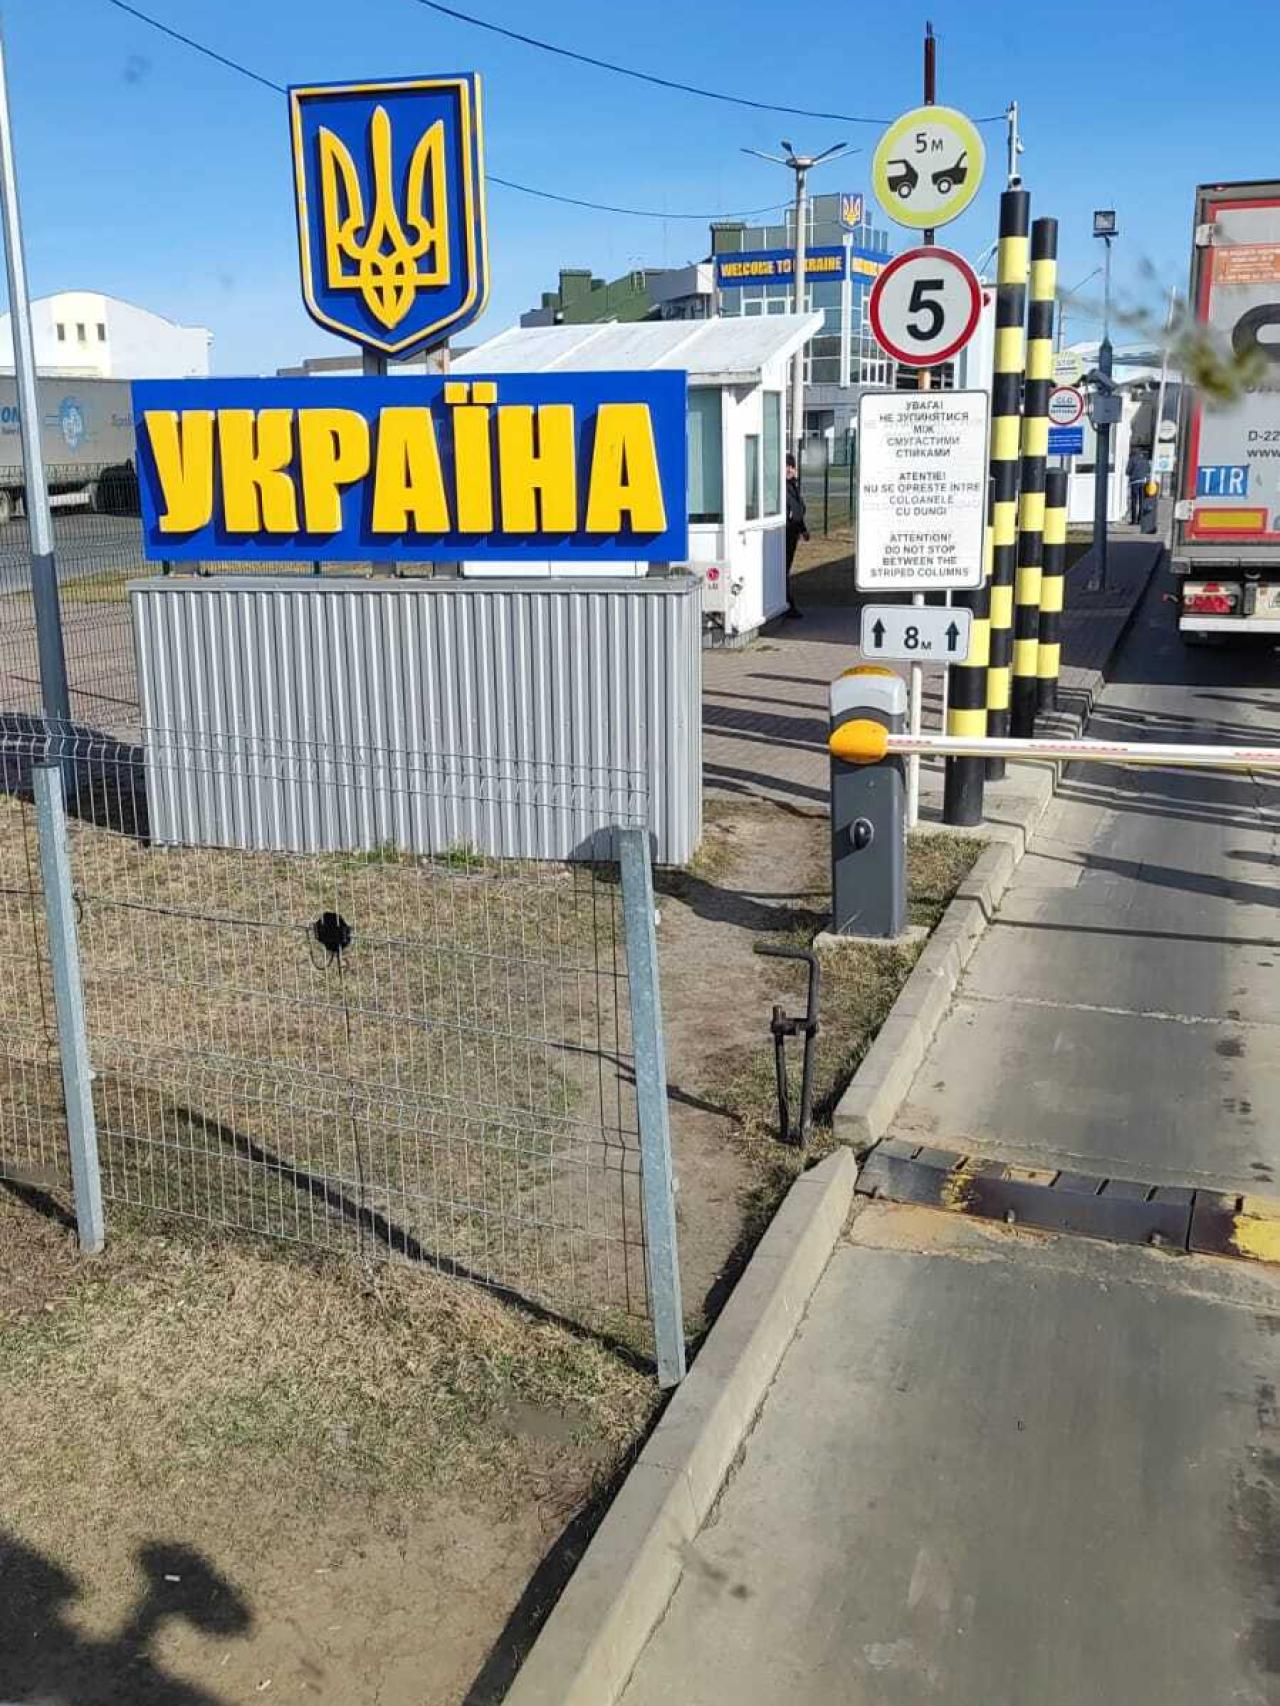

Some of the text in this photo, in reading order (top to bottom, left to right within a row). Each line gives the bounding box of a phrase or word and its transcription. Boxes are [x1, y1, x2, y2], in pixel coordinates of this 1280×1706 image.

[915, 133, 927, 153] 5
[906, 279, 945, 341] 5
[905, 400, 944, 410] УВАГА!
[879, 411, 969, 422] НЕ ЗУПИНЯТИСЯ
[913, 425, 934, 434] МІЖ
[886, 436, 961, 446] СМУГАСТИМИ
[143, 381, 668, 534] УКРАЇНА
[1201, 467, 1244, 494] TIR
[863, 484, 878, 493] NU
[880, 484, 895, 493] SE
[897, 483, 948, 493] OPRESTE
[889, 495, 954, 505] COLOANELE
[895, 506, 947, 516] CU DUNGI
[889, 533, 952, 543] ATTENTION!
[885, 545, 956, 555] DO NOT STOP
[882, 556, 957, 566] BETWEEN THE
[870, 567, 969, 577] STRIPED COLUMNS
[904, 626, 919, 649] 8
